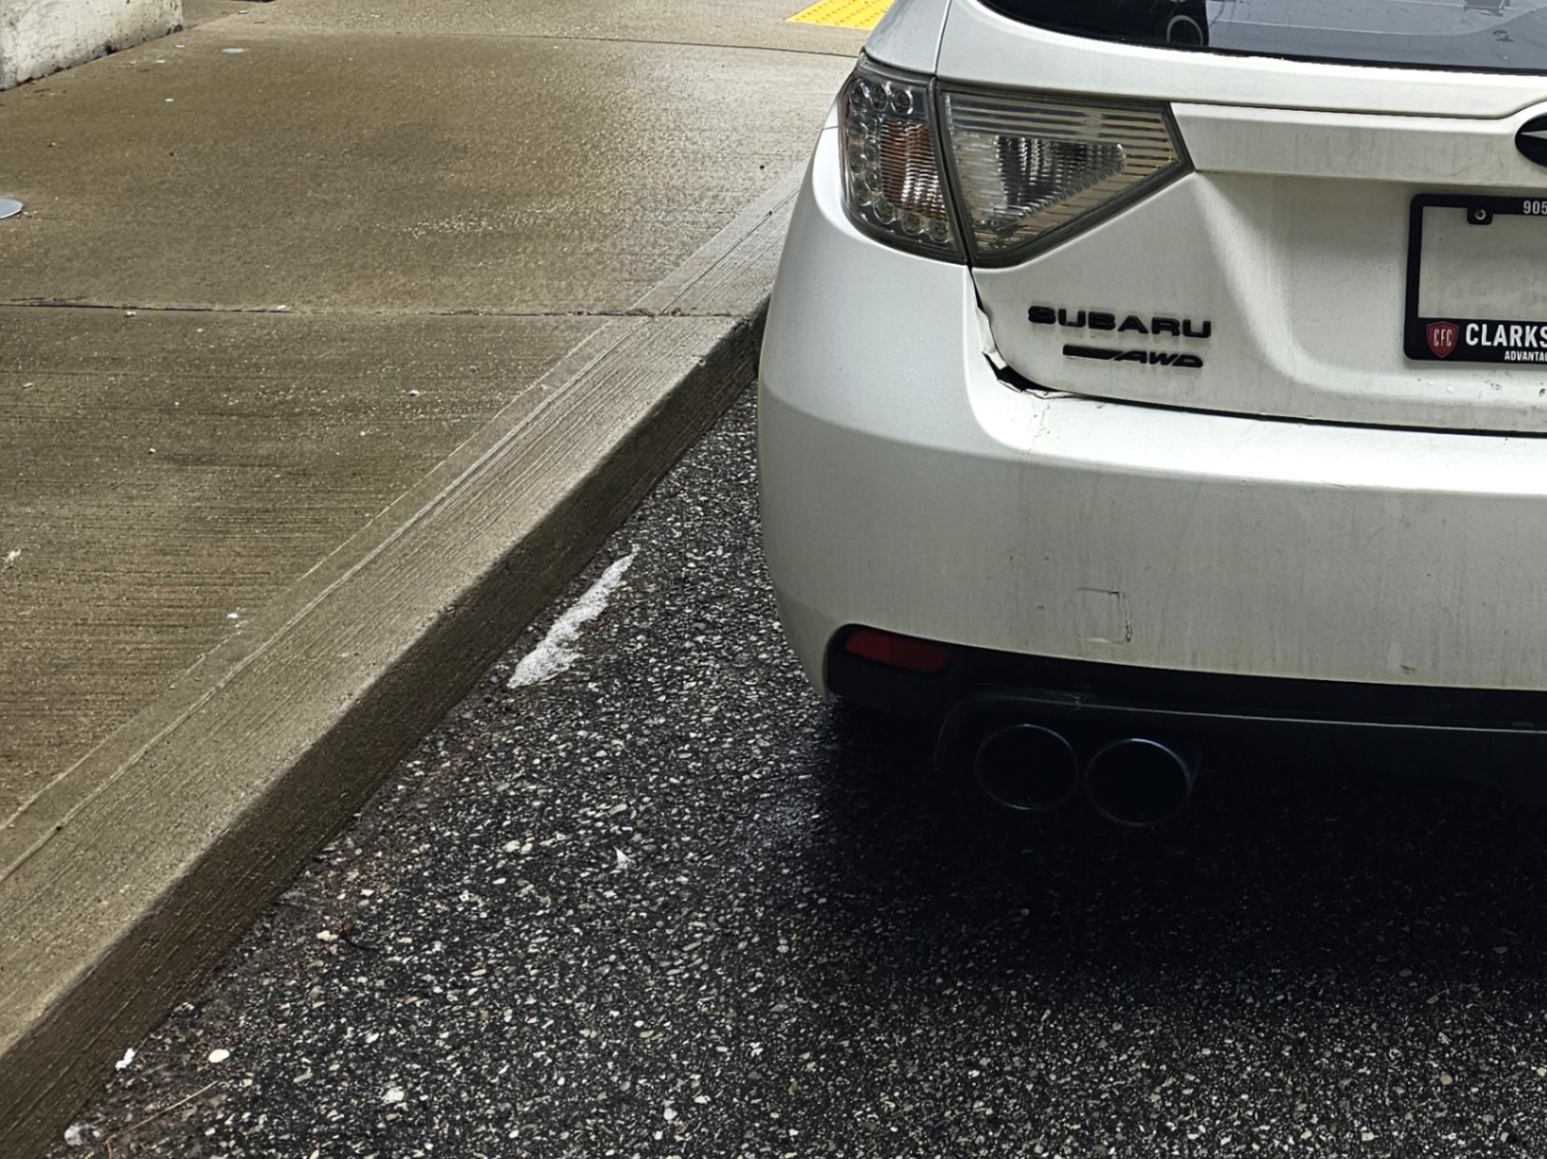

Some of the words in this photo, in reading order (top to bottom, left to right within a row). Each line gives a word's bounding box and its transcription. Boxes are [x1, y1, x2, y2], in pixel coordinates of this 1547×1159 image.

[1027, 305, 1212, 339] SUBARU
[1433, 328, 1452, 347] CFC
[1113, 350, 1203, 368] AWD
